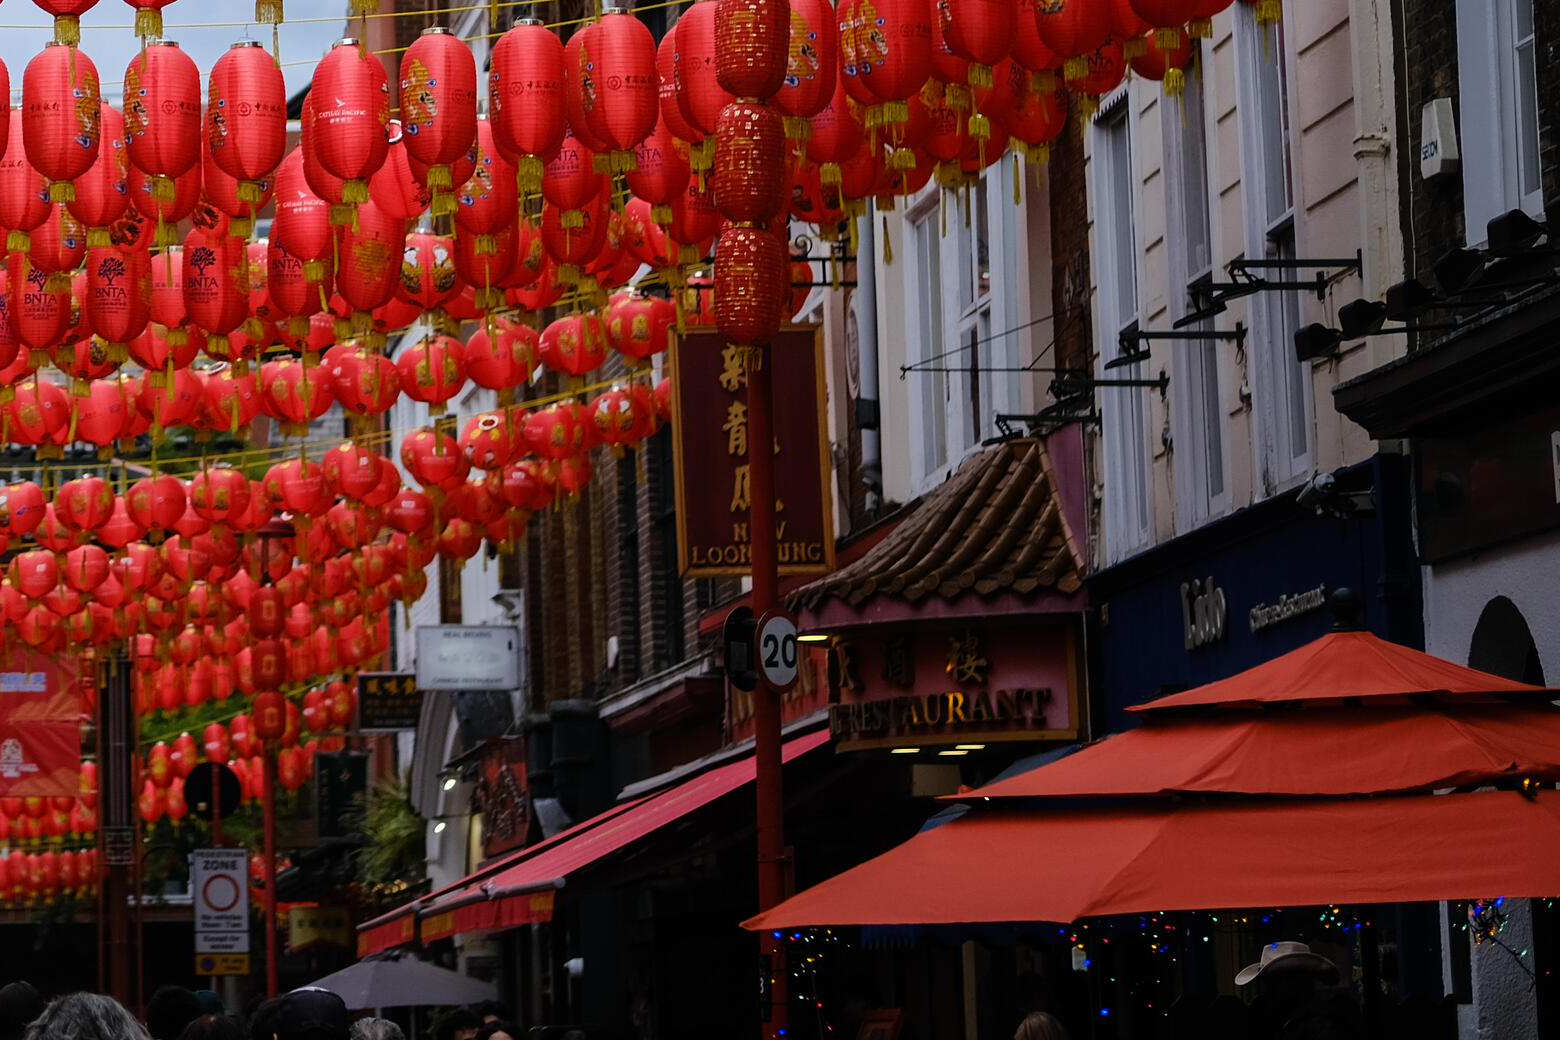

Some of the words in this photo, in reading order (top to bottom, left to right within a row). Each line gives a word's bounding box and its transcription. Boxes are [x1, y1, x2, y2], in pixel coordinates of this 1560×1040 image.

[188, 277, 218, 288] BNTA
[95, 286, 127, 298] BNTA
[24, 293, 57, 305] BNTA
[763, 634, 796, 669] 20
[849, 687, 1052, 732] RESTAURANT
[202, 860, 239, 871] ZONE
